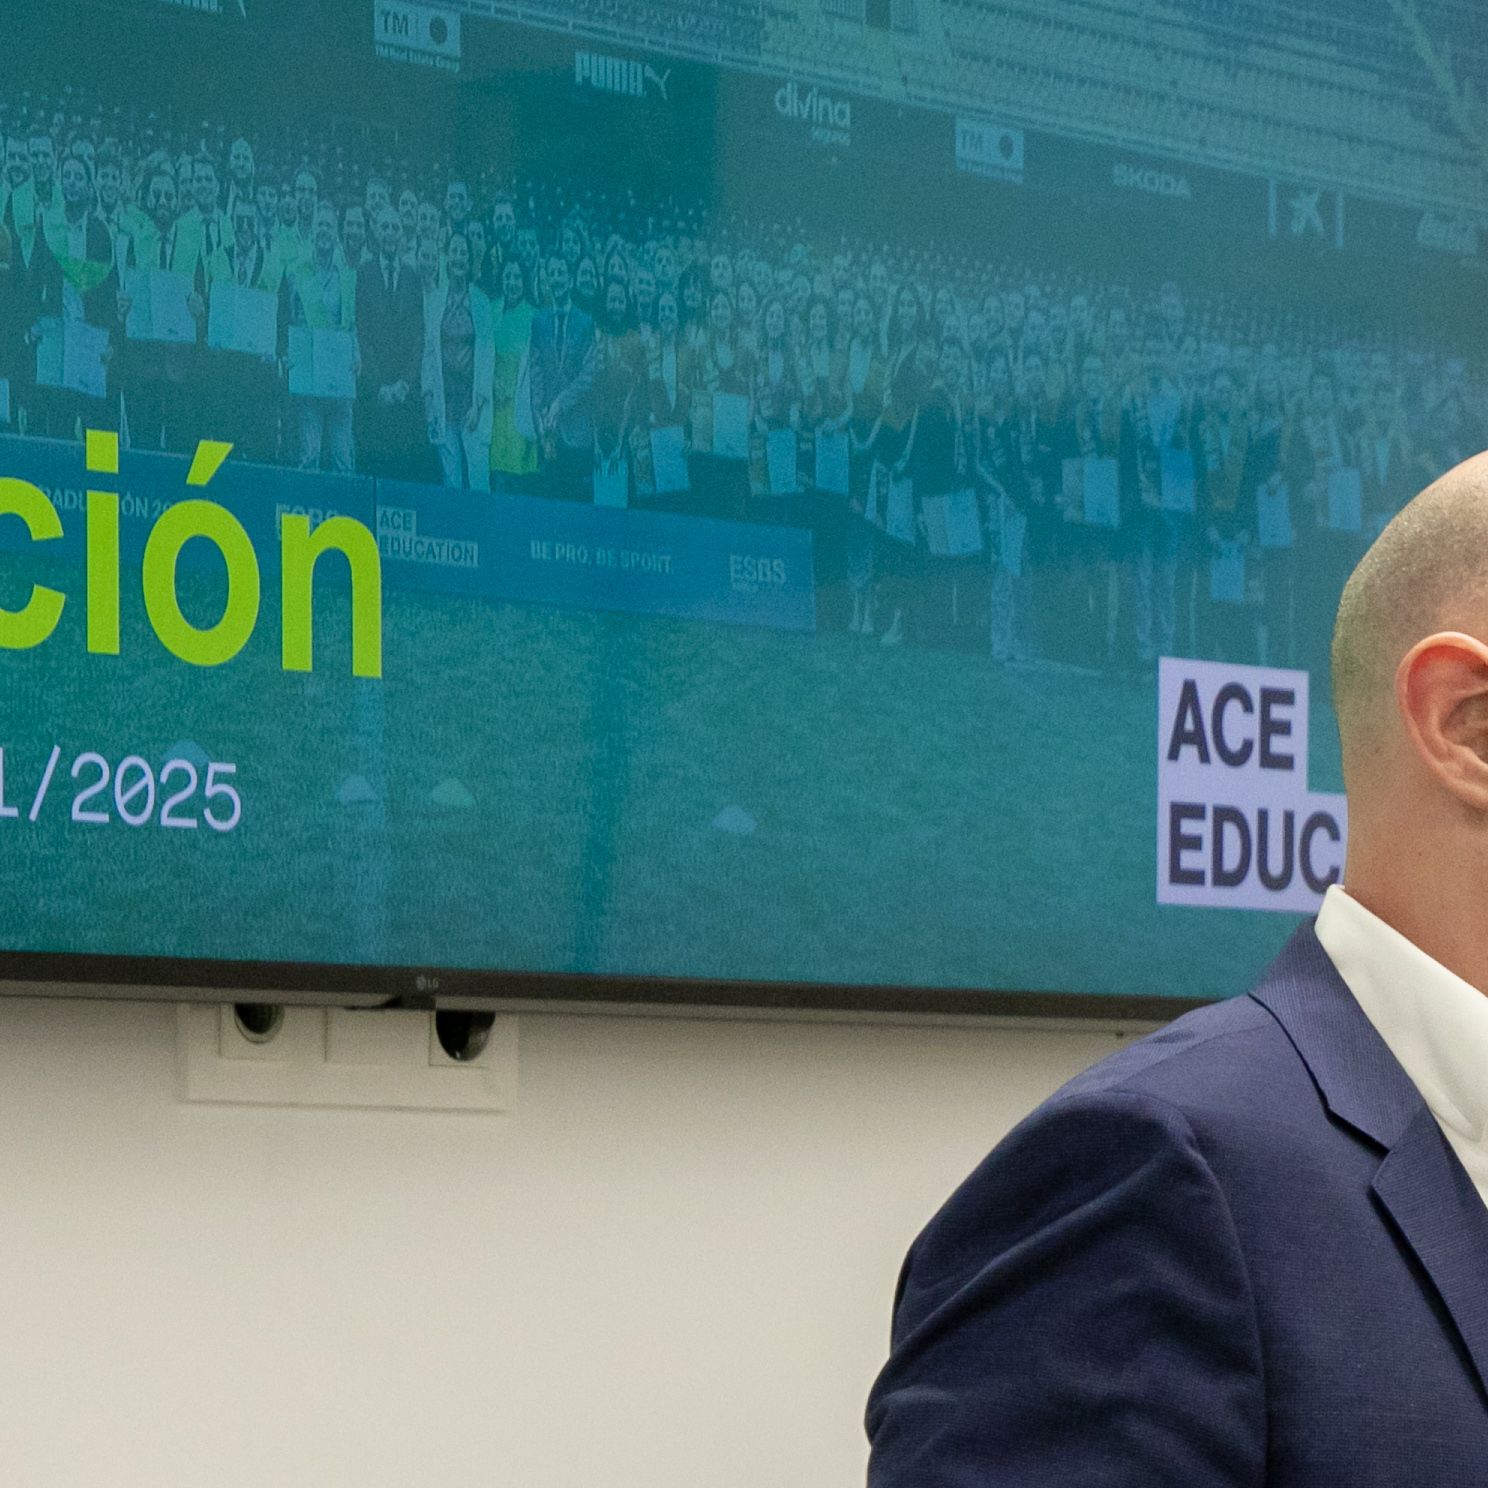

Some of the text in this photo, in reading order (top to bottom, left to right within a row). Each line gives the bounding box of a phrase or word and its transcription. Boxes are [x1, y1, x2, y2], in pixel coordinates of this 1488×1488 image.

[774, 80, 851, 128] divina
[379, 510, 413, 532] ACE
[379, 537, 475, 564] EDUCATION
[1167, 678, 1295, 771] ACE
[1168, 800, 1342, 895] EDUC
